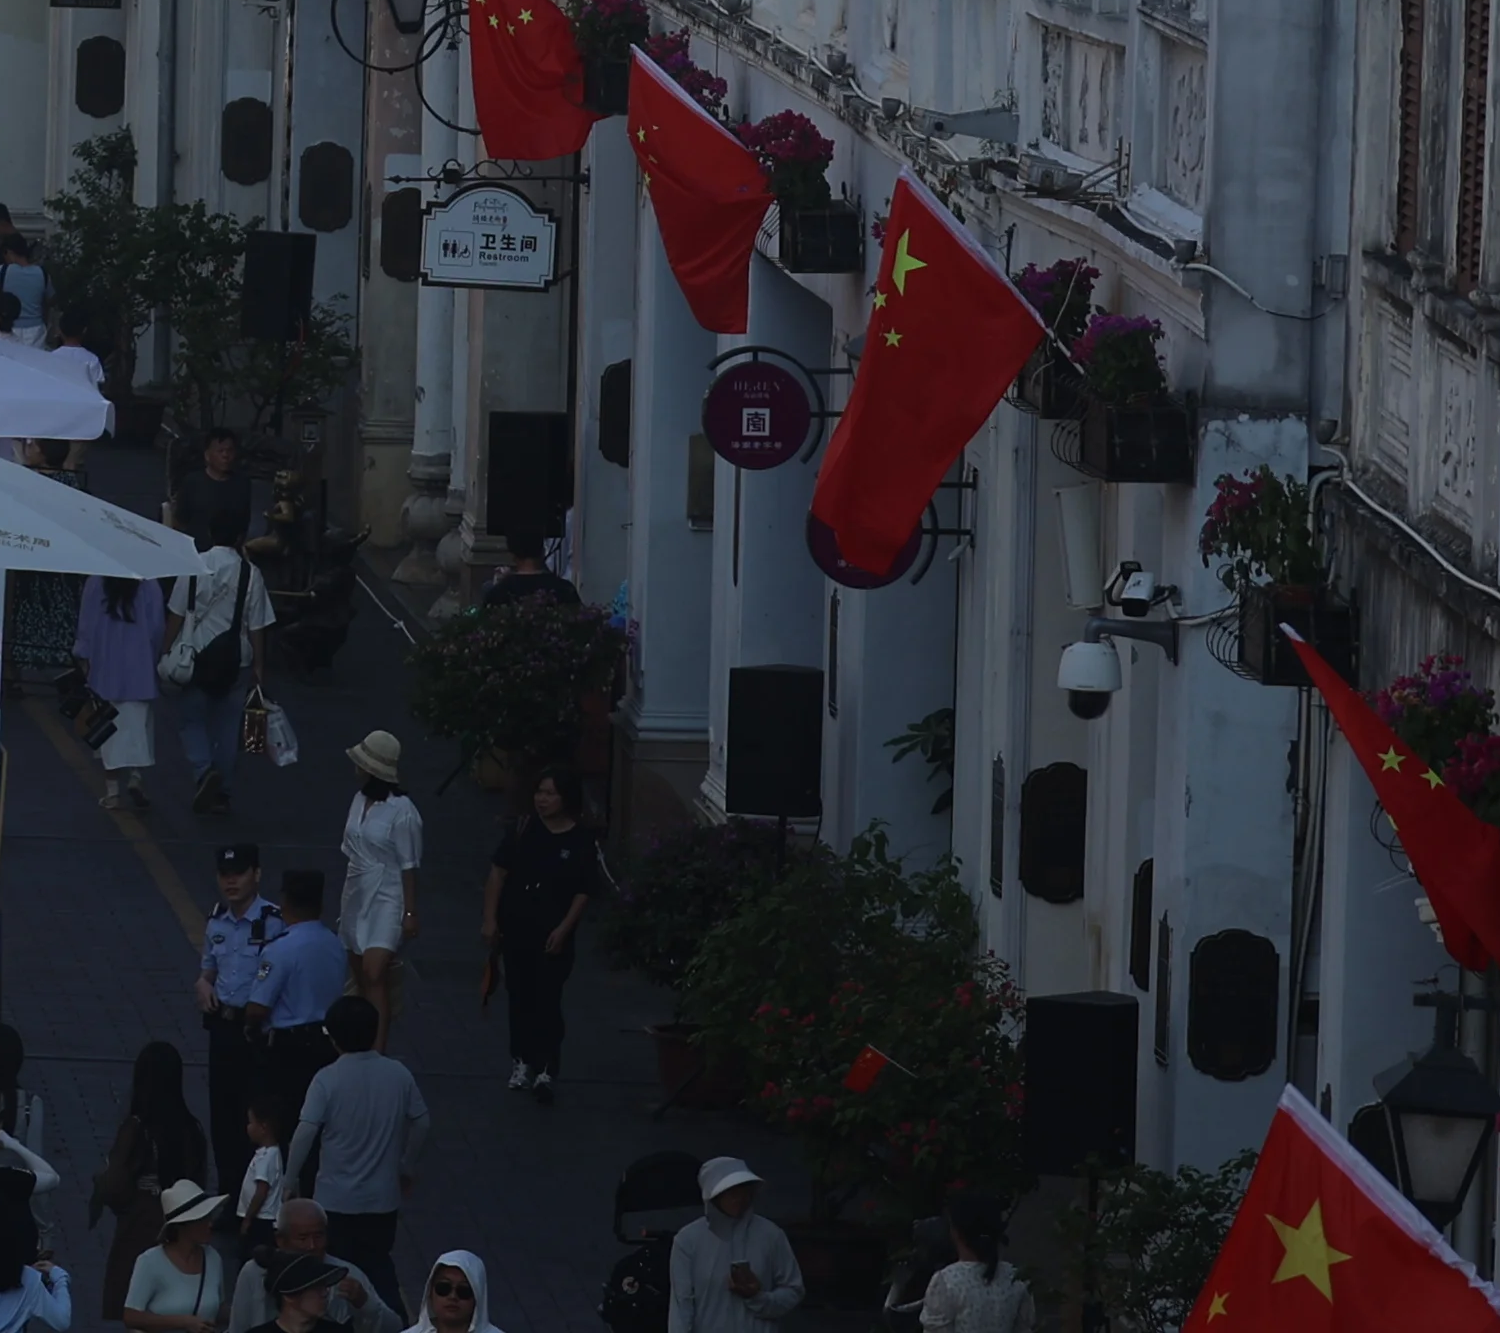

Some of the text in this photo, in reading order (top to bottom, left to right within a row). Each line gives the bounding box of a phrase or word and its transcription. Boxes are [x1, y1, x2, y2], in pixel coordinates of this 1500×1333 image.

[479, 233, 538, 253] 卫生间
[478, 251, 530, 263] Restroom
